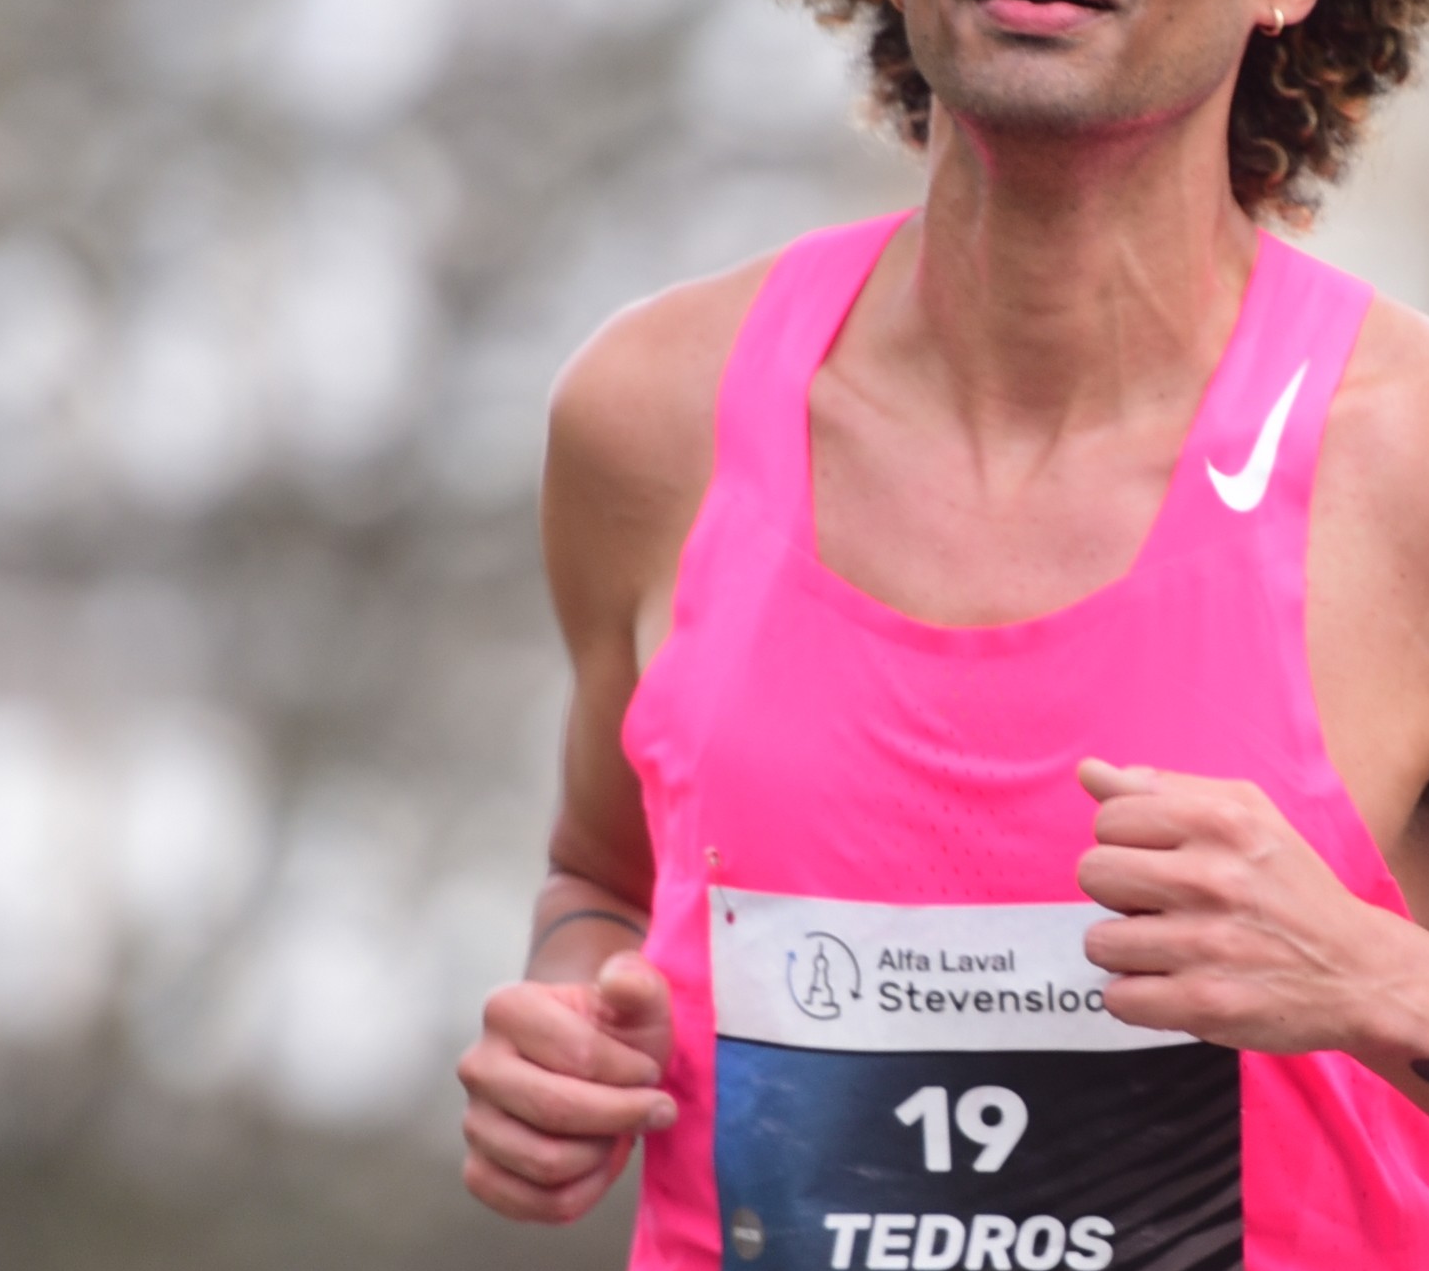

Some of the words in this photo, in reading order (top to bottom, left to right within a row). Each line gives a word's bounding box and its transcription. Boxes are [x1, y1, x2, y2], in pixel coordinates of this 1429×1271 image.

[877, 948, 930, 972] Alfa
[940, 948, 1015, 973] Laval
[878, 981, 1107, 1013] Stevensloo
[894, 1085, 1029, 1173] 19
